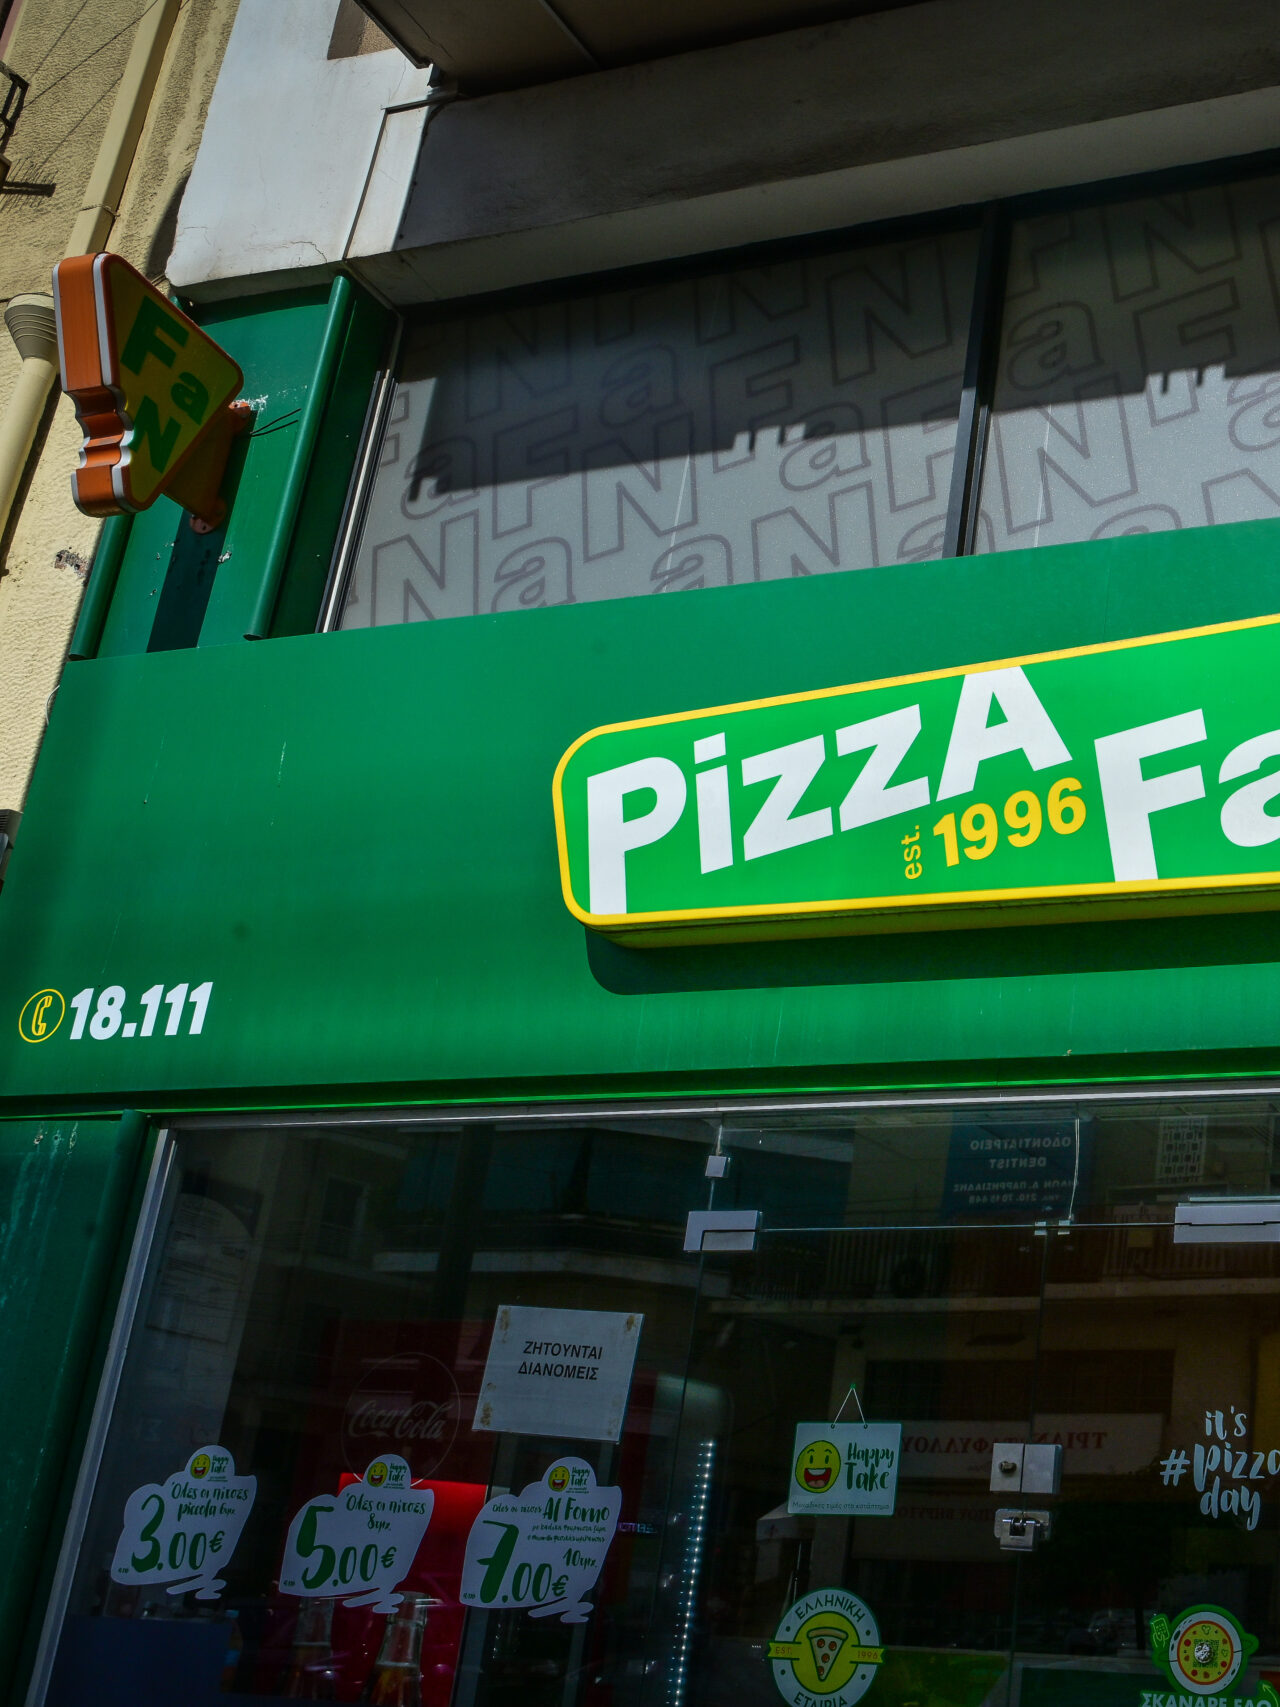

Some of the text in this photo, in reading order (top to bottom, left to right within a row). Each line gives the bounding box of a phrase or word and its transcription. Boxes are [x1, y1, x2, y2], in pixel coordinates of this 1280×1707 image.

[903, 778, 1087, 880] est. 1996
[69, 981, 214, 1041] 18.111
[523, 1341, 603, 1360] ΖΗΤΟΥΝΤΑΙ
[518, 1361, 600, 1380] ΔΙΑΝΟΜΕΙΣ
[1205, 1405, 1248, 1441] it's
[847, 1442, 895, 1468] Happy
[844, 1462, 890, 1492] Take
[564, 1496, 610, 1523] Forno
[1199, 1475, 1261, 1531] day
[794, 1594, 866, 1623] ΕΛΛΗΝΙΚΗ
[857, 1650, 878, 1660] 1996
